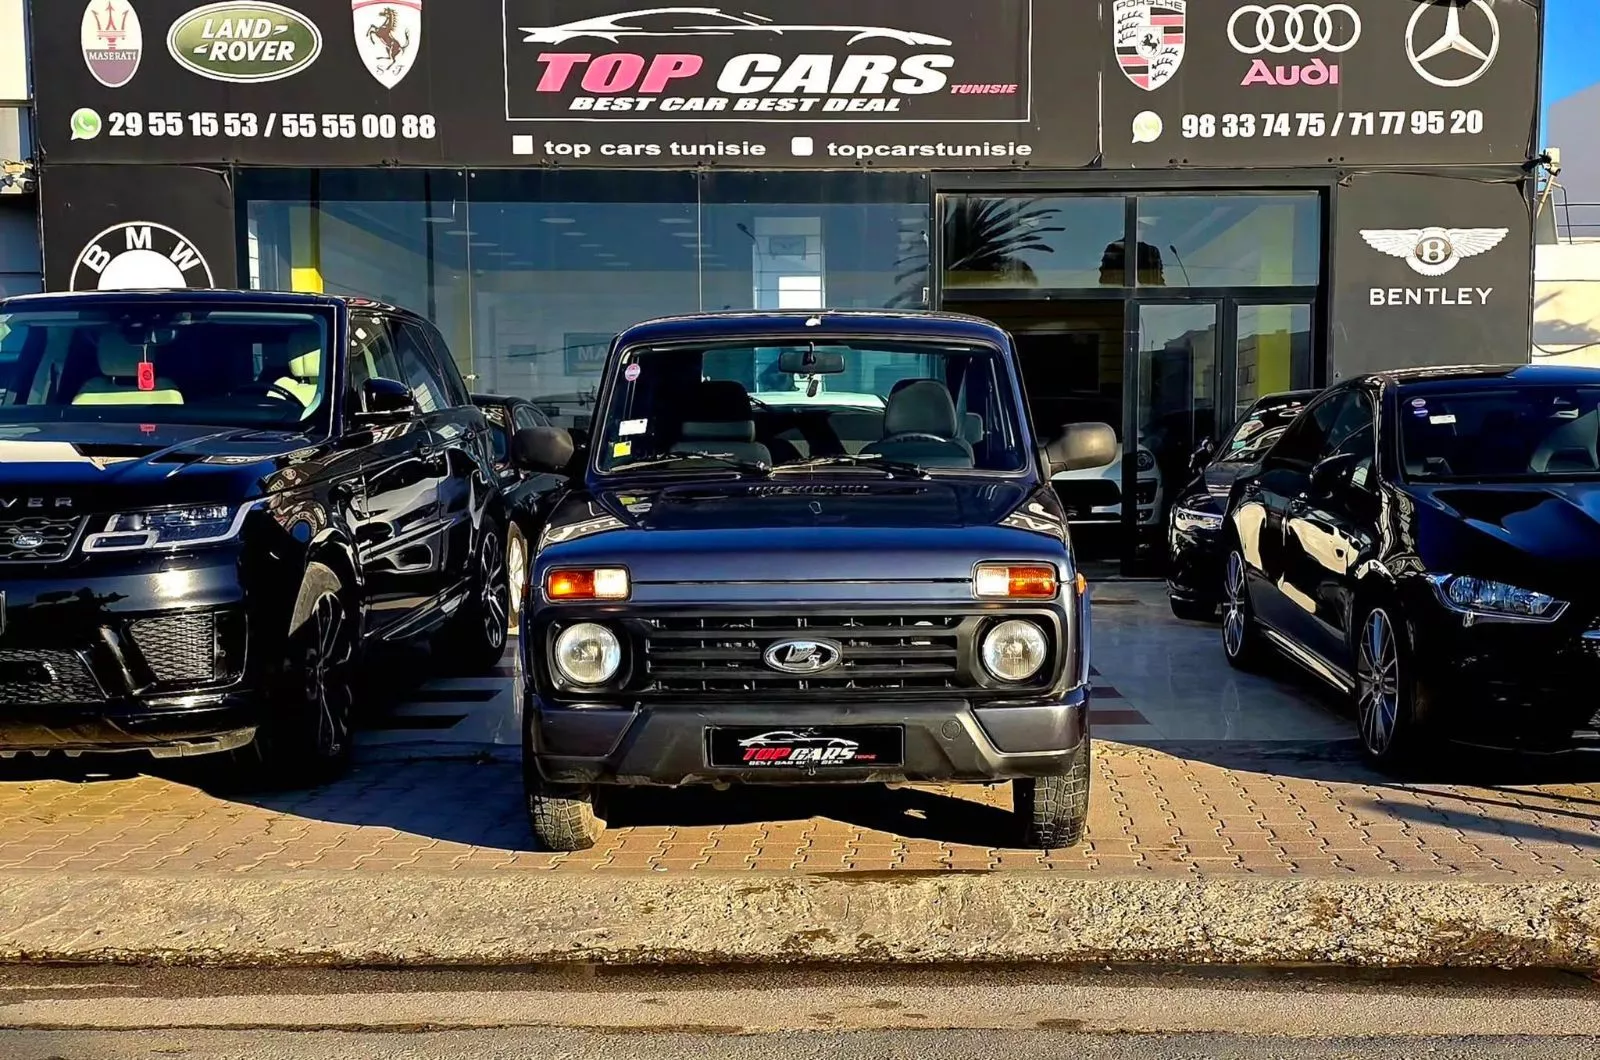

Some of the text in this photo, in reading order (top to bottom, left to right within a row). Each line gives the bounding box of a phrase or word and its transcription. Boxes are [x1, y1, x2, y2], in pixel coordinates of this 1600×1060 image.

[201, 18, 272, 39] LAND
[88, 51, 137, 62] MASERATI
[208, 41, 295, 61] ROVER
[535, 53, 955, 94] TOP CARS
[1240, 57, 1340, 86] Audi
[951, 84, 1018, 94] TUNISIE
[569, 97, 901, 112] BEST CAR BEST DEAL
[109, 112, 436, 139] 29 55 15 53 / 55 55 00 88
[1181, 109, 1484, 138] 98 33 74 75 / 71 77 95 20
[543, 140, 766, 158] top cars tunisie
[827, 141, 1032, 160] topcarstunisie
[81, 226, 201, 275] BMW
[1369, 287, 1493, 306] BENTLEY
[743, 747, 792, 761] TOP
[788, 746, 859, 761] CARS
